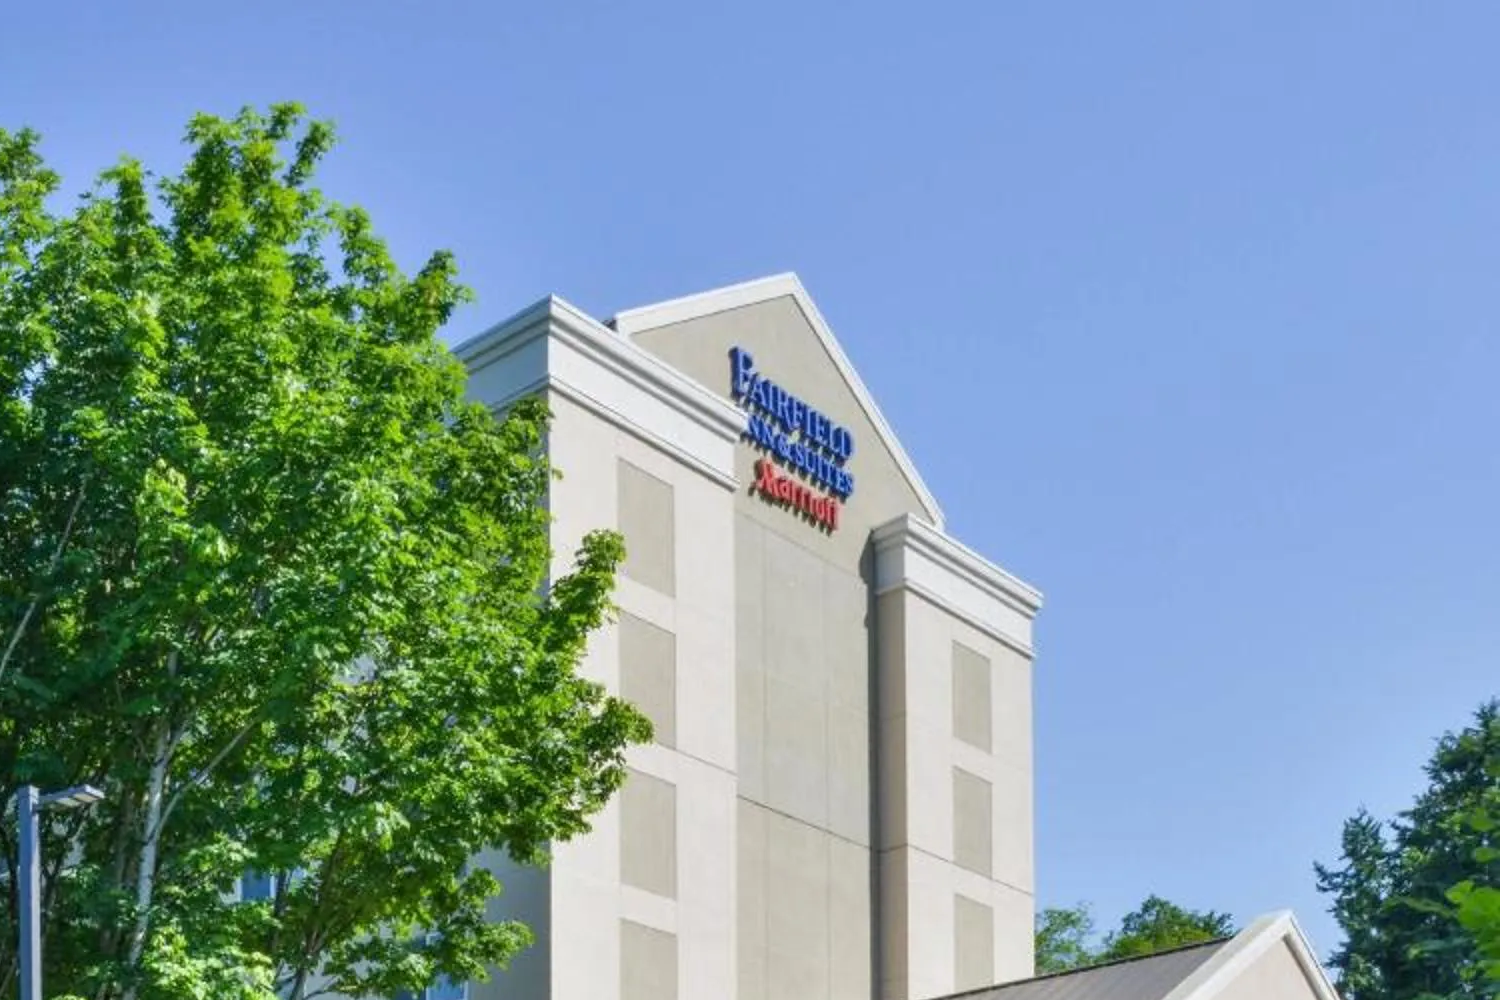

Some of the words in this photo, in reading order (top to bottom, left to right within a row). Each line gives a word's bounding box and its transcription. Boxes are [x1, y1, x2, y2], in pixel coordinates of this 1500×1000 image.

[728, 346, 854, 460] FAIRFIELD
[753, 458, 838, 528] Marriott
[794, 441, 854, 499] SUITES
